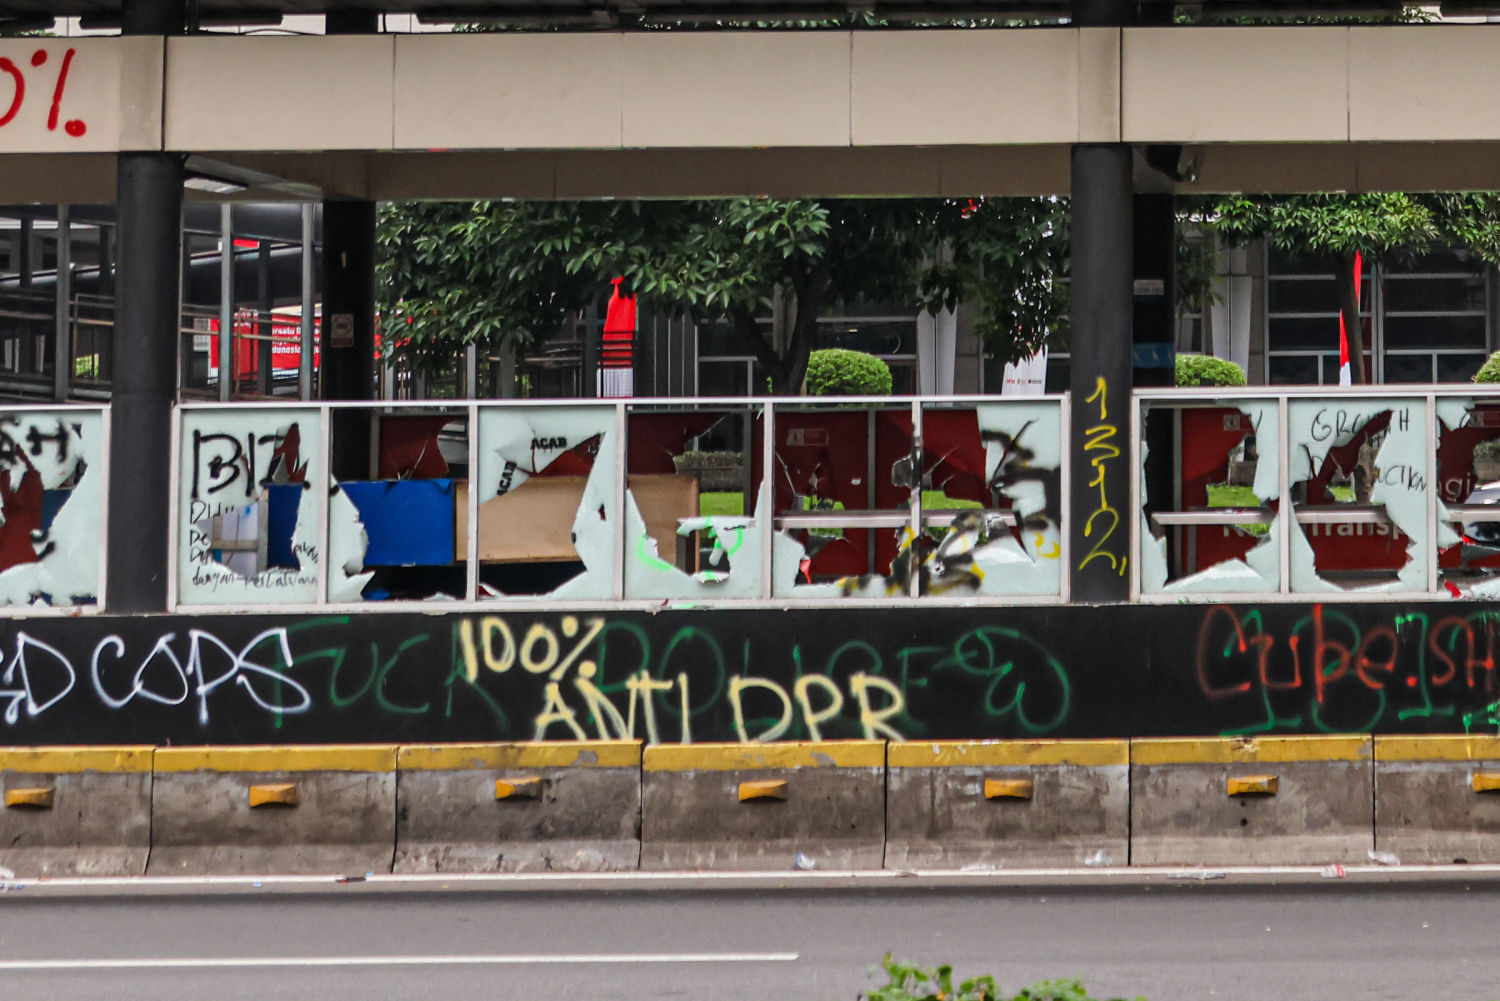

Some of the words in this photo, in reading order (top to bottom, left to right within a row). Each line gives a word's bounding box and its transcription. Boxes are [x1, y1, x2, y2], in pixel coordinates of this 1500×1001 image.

[91, 628, 311, 725] COPS
[459, 615, 604, 683] 100%
[533, 669, 691, 744] ANTI
[728, 670, 907, 744] DPR
